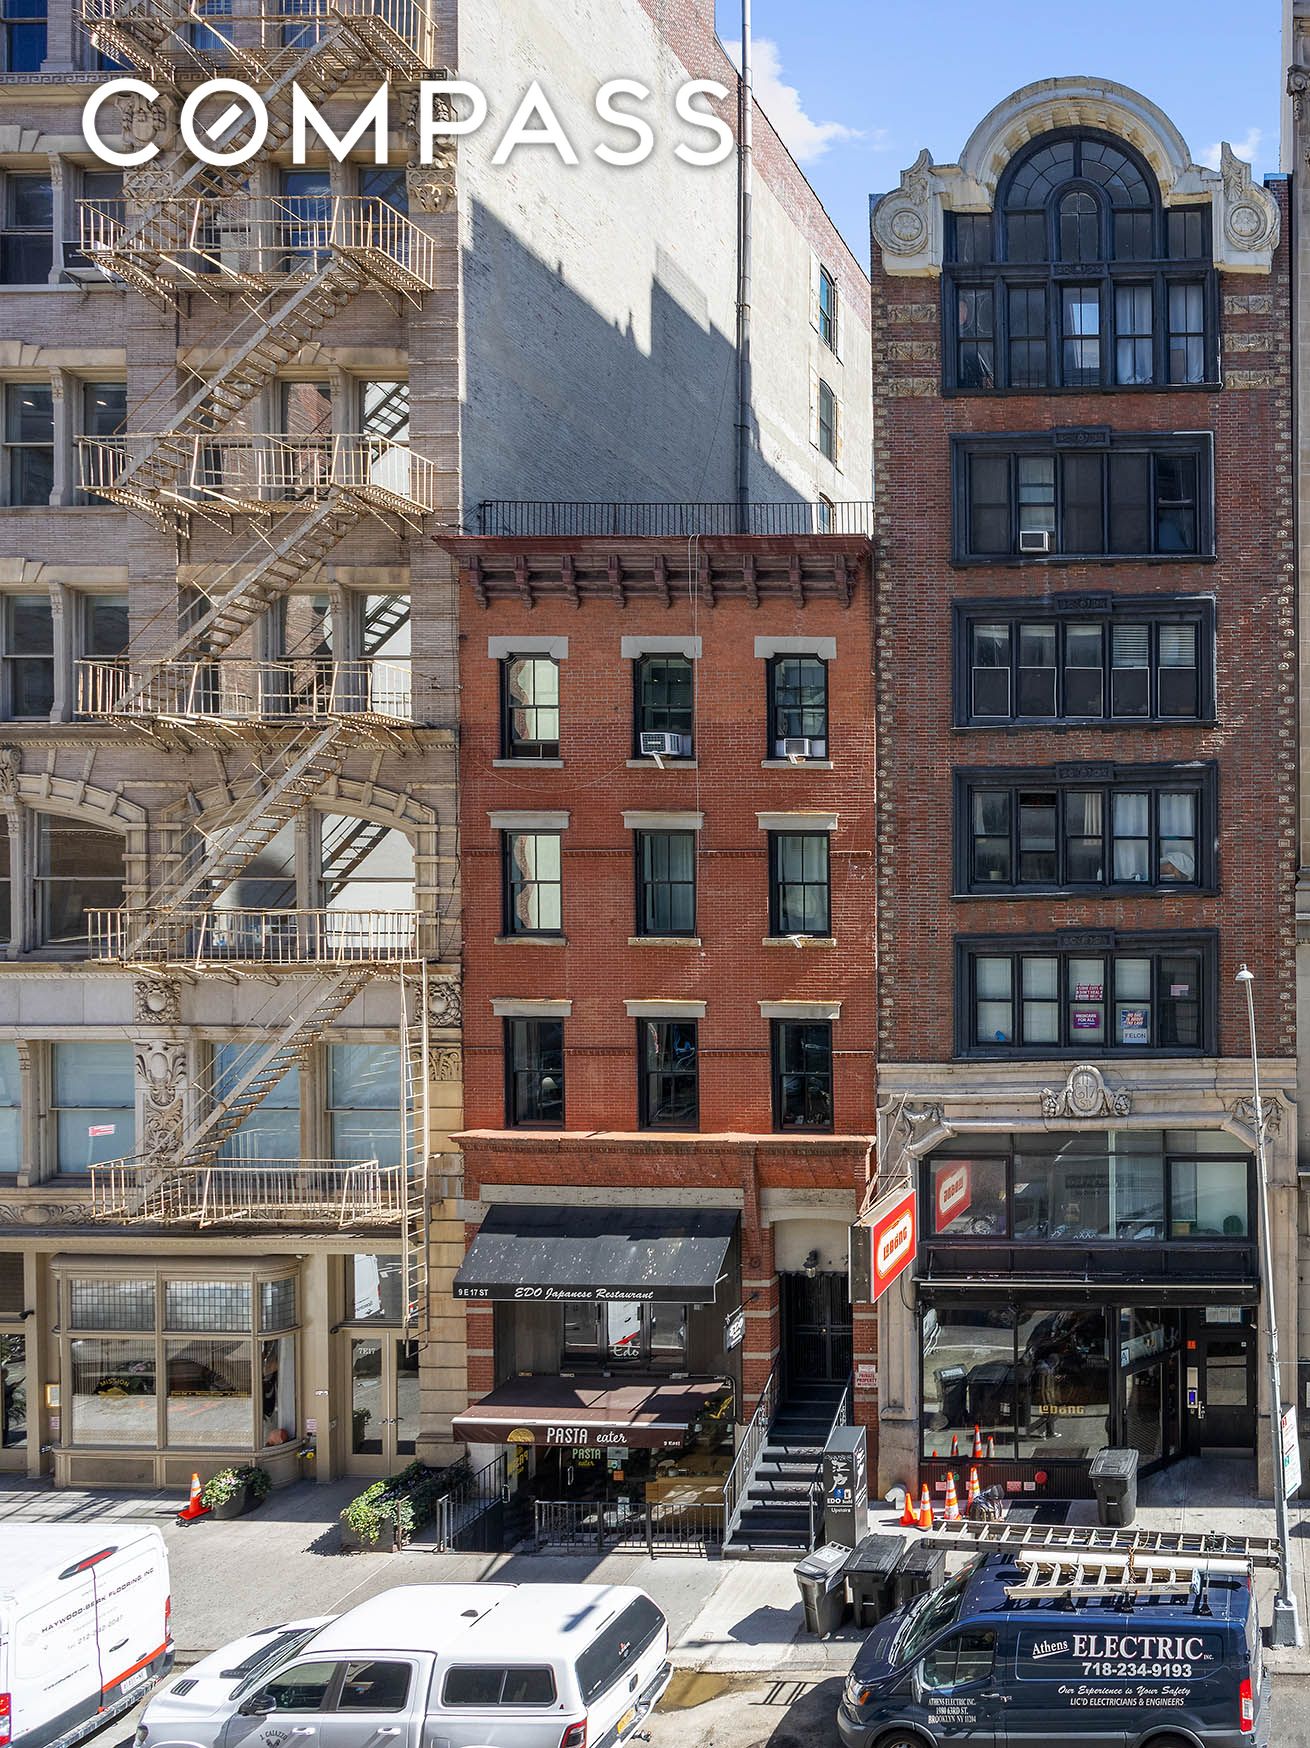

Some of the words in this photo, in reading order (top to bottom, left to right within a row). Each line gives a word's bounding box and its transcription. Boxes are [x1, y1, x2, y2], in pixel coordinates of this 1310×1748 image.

[514, 1288, 543, 1298] EDO
[544, 1288, 592, 1300] Japanese
[596, 1288, 654, 1300] Restaurant
[546, 1428, 588, 1444] PASTA
[596, 1431, 628, 1444] eater
[572, 1448, 600, 1459] PASTA
[577, 1460, 594, 1468] eater
[108, 1574, 142, 1598] FLOORING
[1032, 1640, 1068, 1656] Athens
[1072, 1634, 1204, 1660] ELECTRIC
[1082, 1662, 1193, 1678] 718-234-9193
[1058, 1685, 1074, 1694] Our
[1077, 1685, 1122, 1696] Experience
[1125, 1686, 1132, 1694] is
[1136, 1685, 1158, 1695] Your
[1161, 1685, 1191, 1697] Safety
[928, 1698, 945, 1706] ATHENS
[945, 1698, 966, 1706] ELECTRIC
[1070, 1698, 1088, 1706] LIC'D
[1089, 1698, 1137, 1706] ELECTRICIANS
[1138, 1698, 1144, 1706] &
[1145, 1698, 1185, 1706] ENGINEERS
[928, 1716, 955, 1724] BROOKLYN
